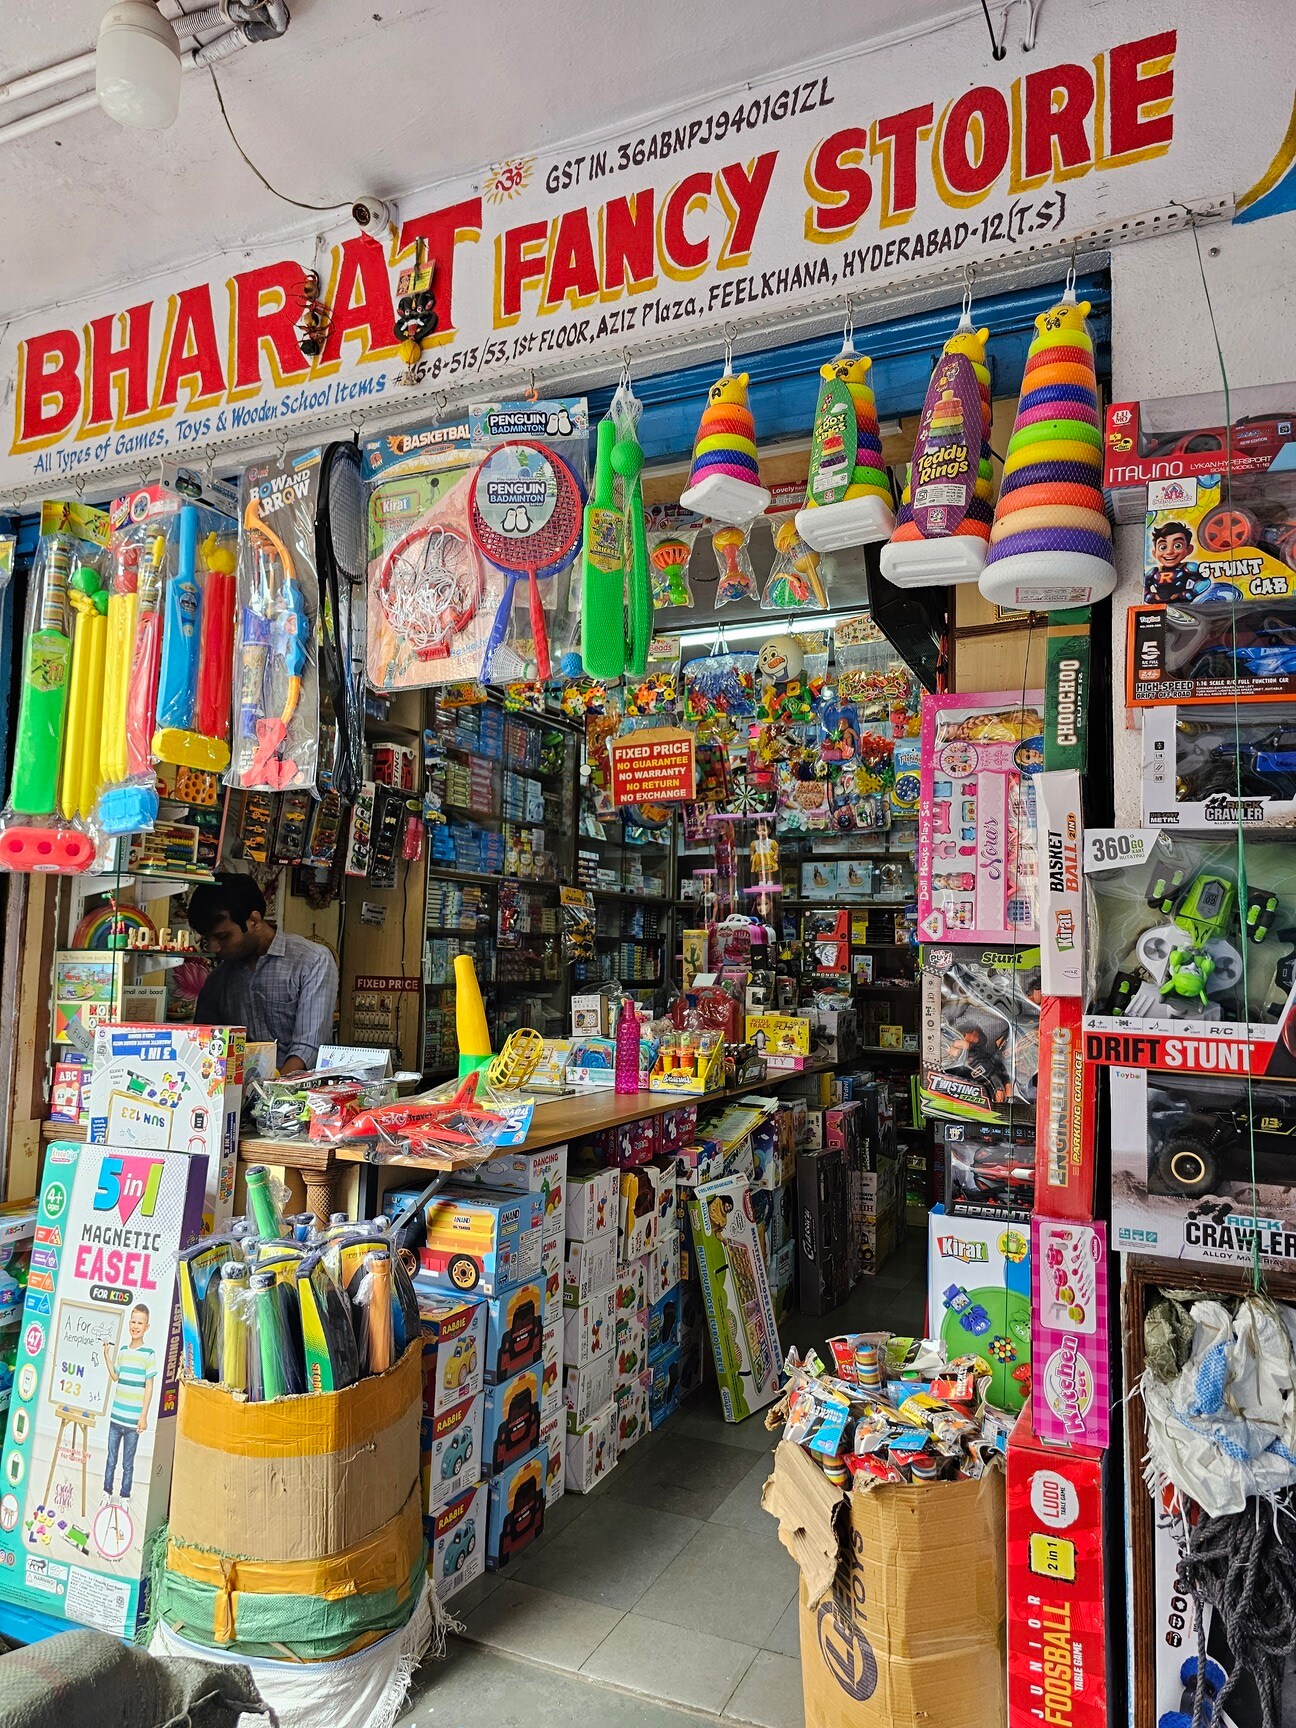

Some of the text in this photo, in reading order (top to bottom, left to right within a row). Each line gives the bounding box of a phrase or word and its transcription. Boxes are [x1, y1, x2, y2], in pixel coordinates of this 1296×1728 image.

[545, 157, 585, 194] GST
[20, 29, 1178, 442] BHARAT FANCY STORE
[596, 306, 638, 339] AZIZ
[33, 373, 388, 475] All Types of Games, Toys & Wooden School Items
[489, 411, 547, 427] PENGUIN
[491, 423, 546, 434] BADMINTON
[814, 413, 847, 438] TEDDY
[402, 423, 470, 450] BASKETBAL
[917, 444, 968, 472] Teddy
[1190, 456, 1272, 470] LYKAN HYPERSPORT
[1232, 463, 1254, 471] MODEL
[919, 459, 970, 485] Rings
[1109, 461, 1183, 483] ITALINO
[488, 482, 546, 495] PENGUIN
[772, 485, 795, 495] Lovely
[382, 496, 408, 513] Kirat
[489, 494, 545, 504] BADMINTON
[1160, 571, 1174, 584] R
[1198, 558, 1262, 578] STUNT
[1250, 578, 1287, 596] CAR
[1057, 659, 1080, 746] CHOOCHOO
[615, 742, 690, 760] FIXED PRICE
[632, 756, 689, 769] GUARANTEE
[619, 767, 686, 781] NO WARRANTY
[626, 779, 680, 791] NO RETURN
[620, 789, 686, 802] NO EXCHANGE
[1226, 800, 1263, 809] ROCK
[1205, 808, 1263, 821] CRAWLER
[1068, 821, 1076, 832] IN
[919, 801, 931, 901] Doll House Play Set
[980, 816, 1003, 881] Nora's
[1131, 839, 1144, 849] GO
[1047, 829, 1065, 893] BASKET
[1063, 843, 1079, 893] BALL
[1056, 912, 1074, 948] Kirat
[981, 952, 1023, 964] Stunt
[357, 978, 419, 990] FIXED PRICE
[1210, 1027, 1233, 1035] R/C
[140, 1047, 172, 1060] 3 IN 1
[1086, 1035, 1160, 1064] DRIFT
[1164, 1039, 1255, 1071] STUNT
[58, 1070, 78, 1082] ABC
[930, 1075, 980, 1097] TWISTING
[1048, 1027, 1071, 1187] ENGINEERING
[1072, 1051, 1083, 1164] PARKING GARAGE
[121, 1107, 165, 1127] SUN 123
[533, 1153, 559, 1168] DANCING
[93, 1157, 123, 1211] 5
[124, 1174, 143, 1197] in
[47, 1187, 64, 1201] 4+
[454, 1216, 470, 1224] ANAND
[501, 1208, 520, 1224] ANAND
[1226, 1216, 1281, 1231] ROCK
[82, 1224, 161, 1252] MAGNETIC
[1186, 1221, 1296, 1258] CRAWLER
[941, 1238, 983, 1258] Kirat
[1203, 1251, 1233, 1260] ALLOY
[74, 1244, 157, 1290] EASEL
[93, 1288, 130, 1302] FOR KIDS
[750, 1227, 782, 1371] MULTIPURPOSE LUDO TABLE
[697, 1246, 725, 1374] MULTIPURPOSE LUDO TABLE
[64, 1315, 71, 1330] A
[442, 1316, 467, 1335] RABBIE
[28, 1330, 41, 1346] 47
[64, 1332, 94, 1348] Aeroplane
[61, 1361, 85, 1378] SUN
[166, 1336, 181, 1384] LERNING
[59, 1379, 82, 1397] 123
[1056, 1335, 1087, 1434] Kitchen
[436, 1409, 462, 1433] RABBIE
[1042, 1480, 1060, 1519] LUDO
[438, 1503, 465, 1530] RABBIE
[1047, 1549, 1058, 1561] in
[851, 1525, 868, 1621] TOYS
[1047, 1562, 1059, 1571] 2
[1027, 1595, 1044, 1720] JUNIOR
[1042, 1601, 1074, 1727] FOOSBALL
[1073, 1642, 1084, 1691] TABLE GAME
